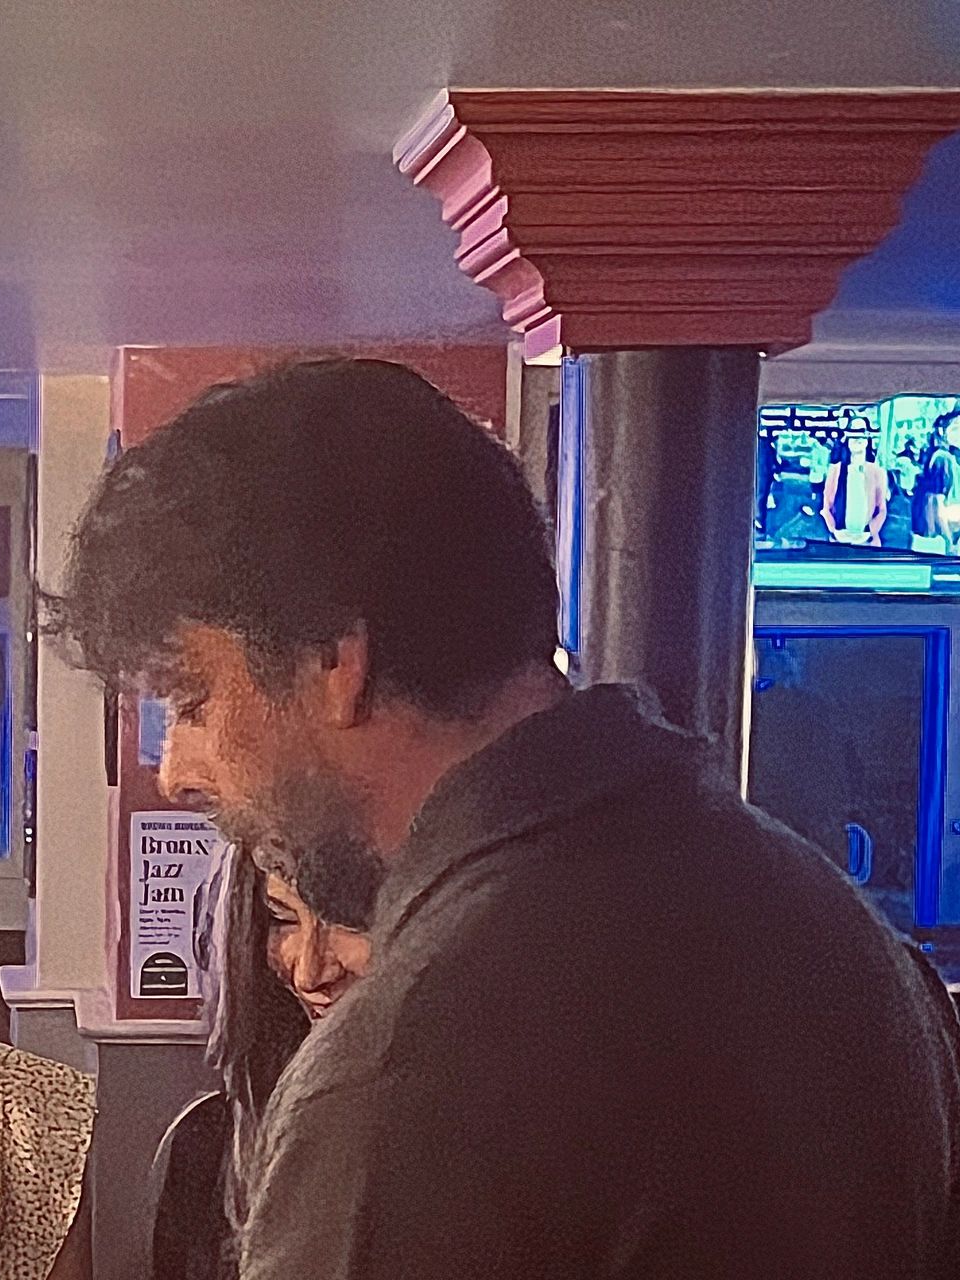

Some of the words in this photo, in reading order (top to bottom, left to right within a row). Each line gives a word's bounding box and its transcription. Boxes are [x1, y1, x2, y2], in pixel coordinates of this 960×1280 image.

[141, 836, 209, 856] Bronx
[139, 859, 184, 883] Jazz
[138, 883, 185, 906] Jam
